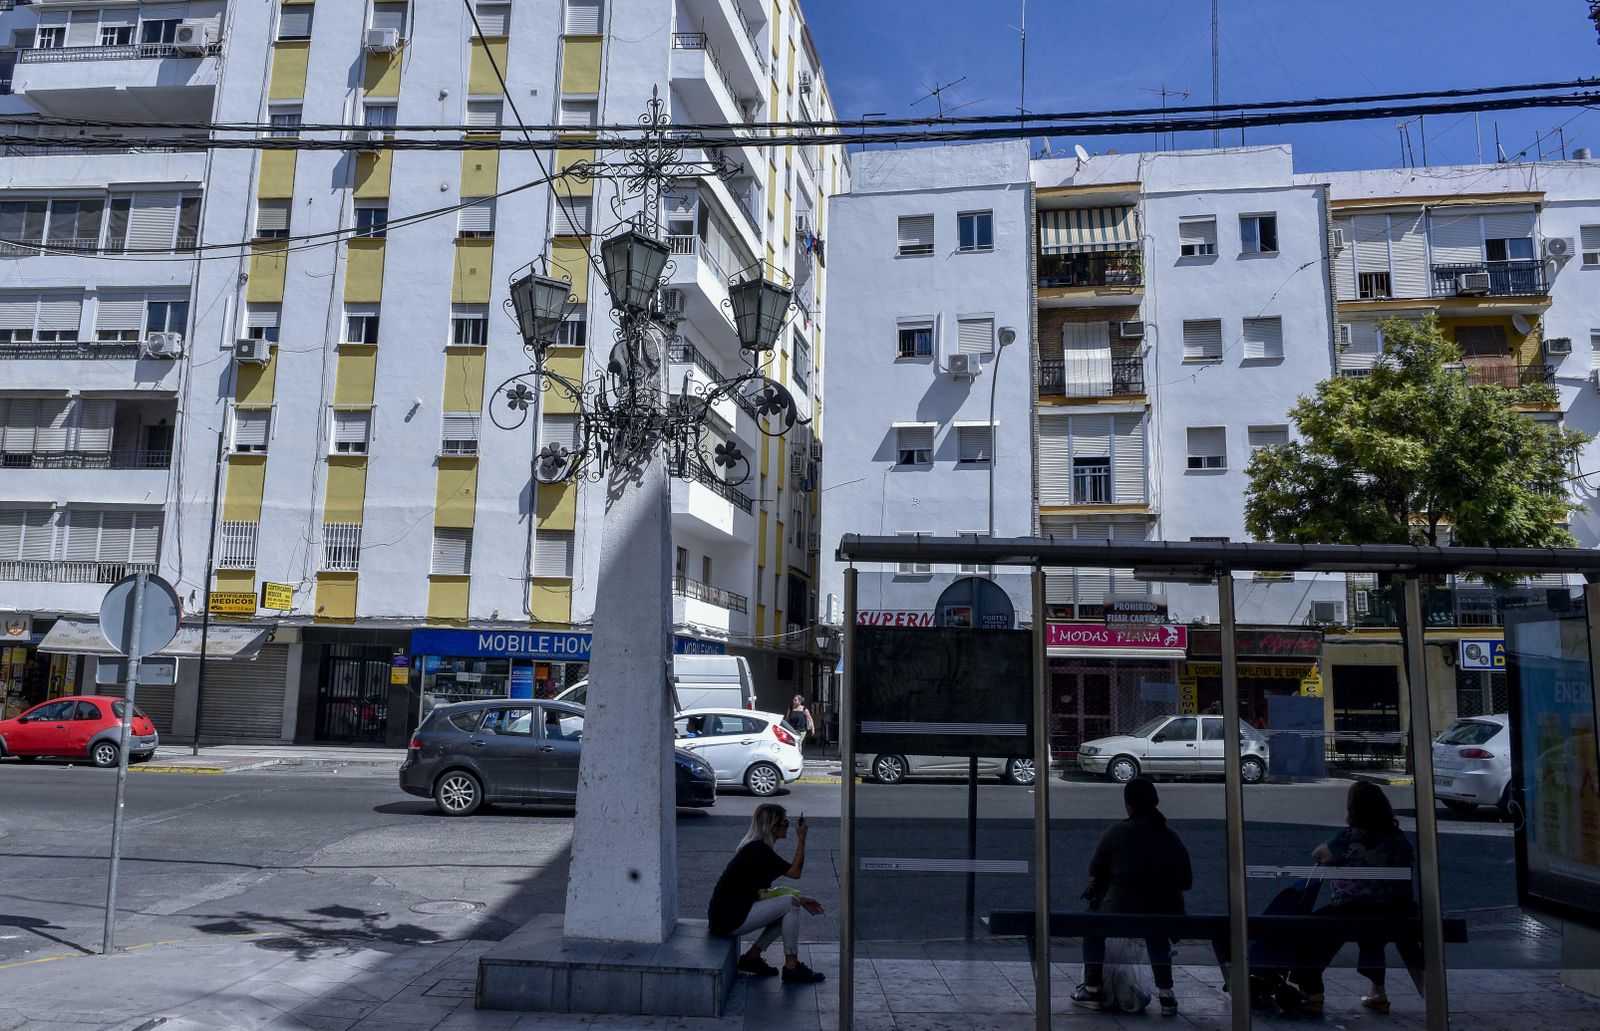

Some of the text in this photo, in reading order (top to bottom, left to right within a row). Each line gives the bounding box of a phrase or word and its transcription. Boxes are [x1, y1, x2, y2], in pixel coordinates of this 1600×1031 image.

[1113, 601, 1158, 611] PROHIBIDO
[1107, 614, 1128, 622] FIJAR
[1059, 630, 1109, 642] MODAS
[478, 633, 592, 655] MOBILE HOM
